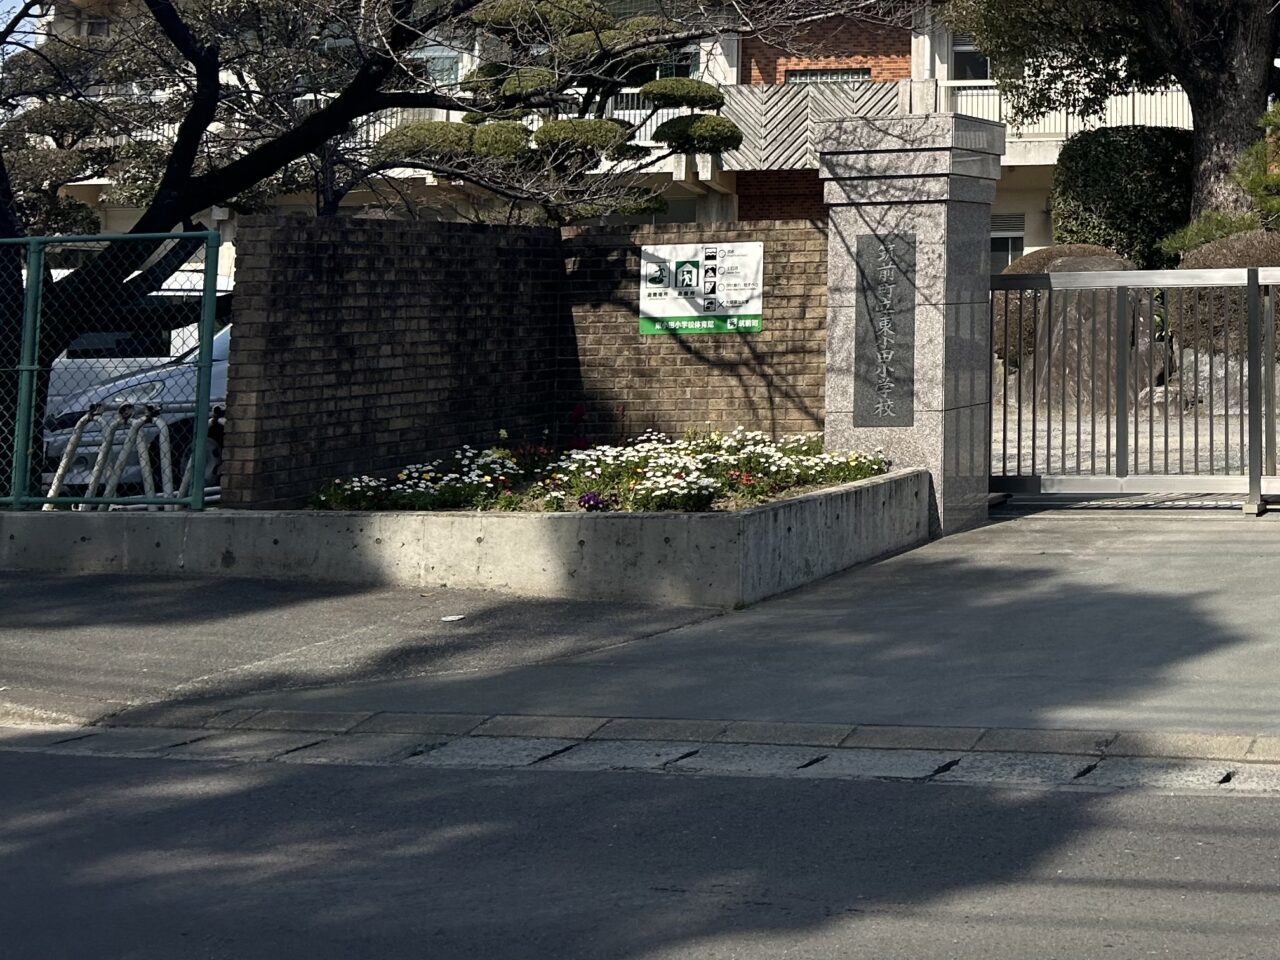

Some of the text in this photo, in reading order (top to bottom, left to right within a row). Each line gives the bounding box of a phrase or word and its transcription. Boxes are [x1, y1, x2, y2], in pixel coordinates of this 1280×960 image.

[738, 319, 759, 328] 筑前町
[873, 243, 897, 418] 筑前町立東小田小学校
